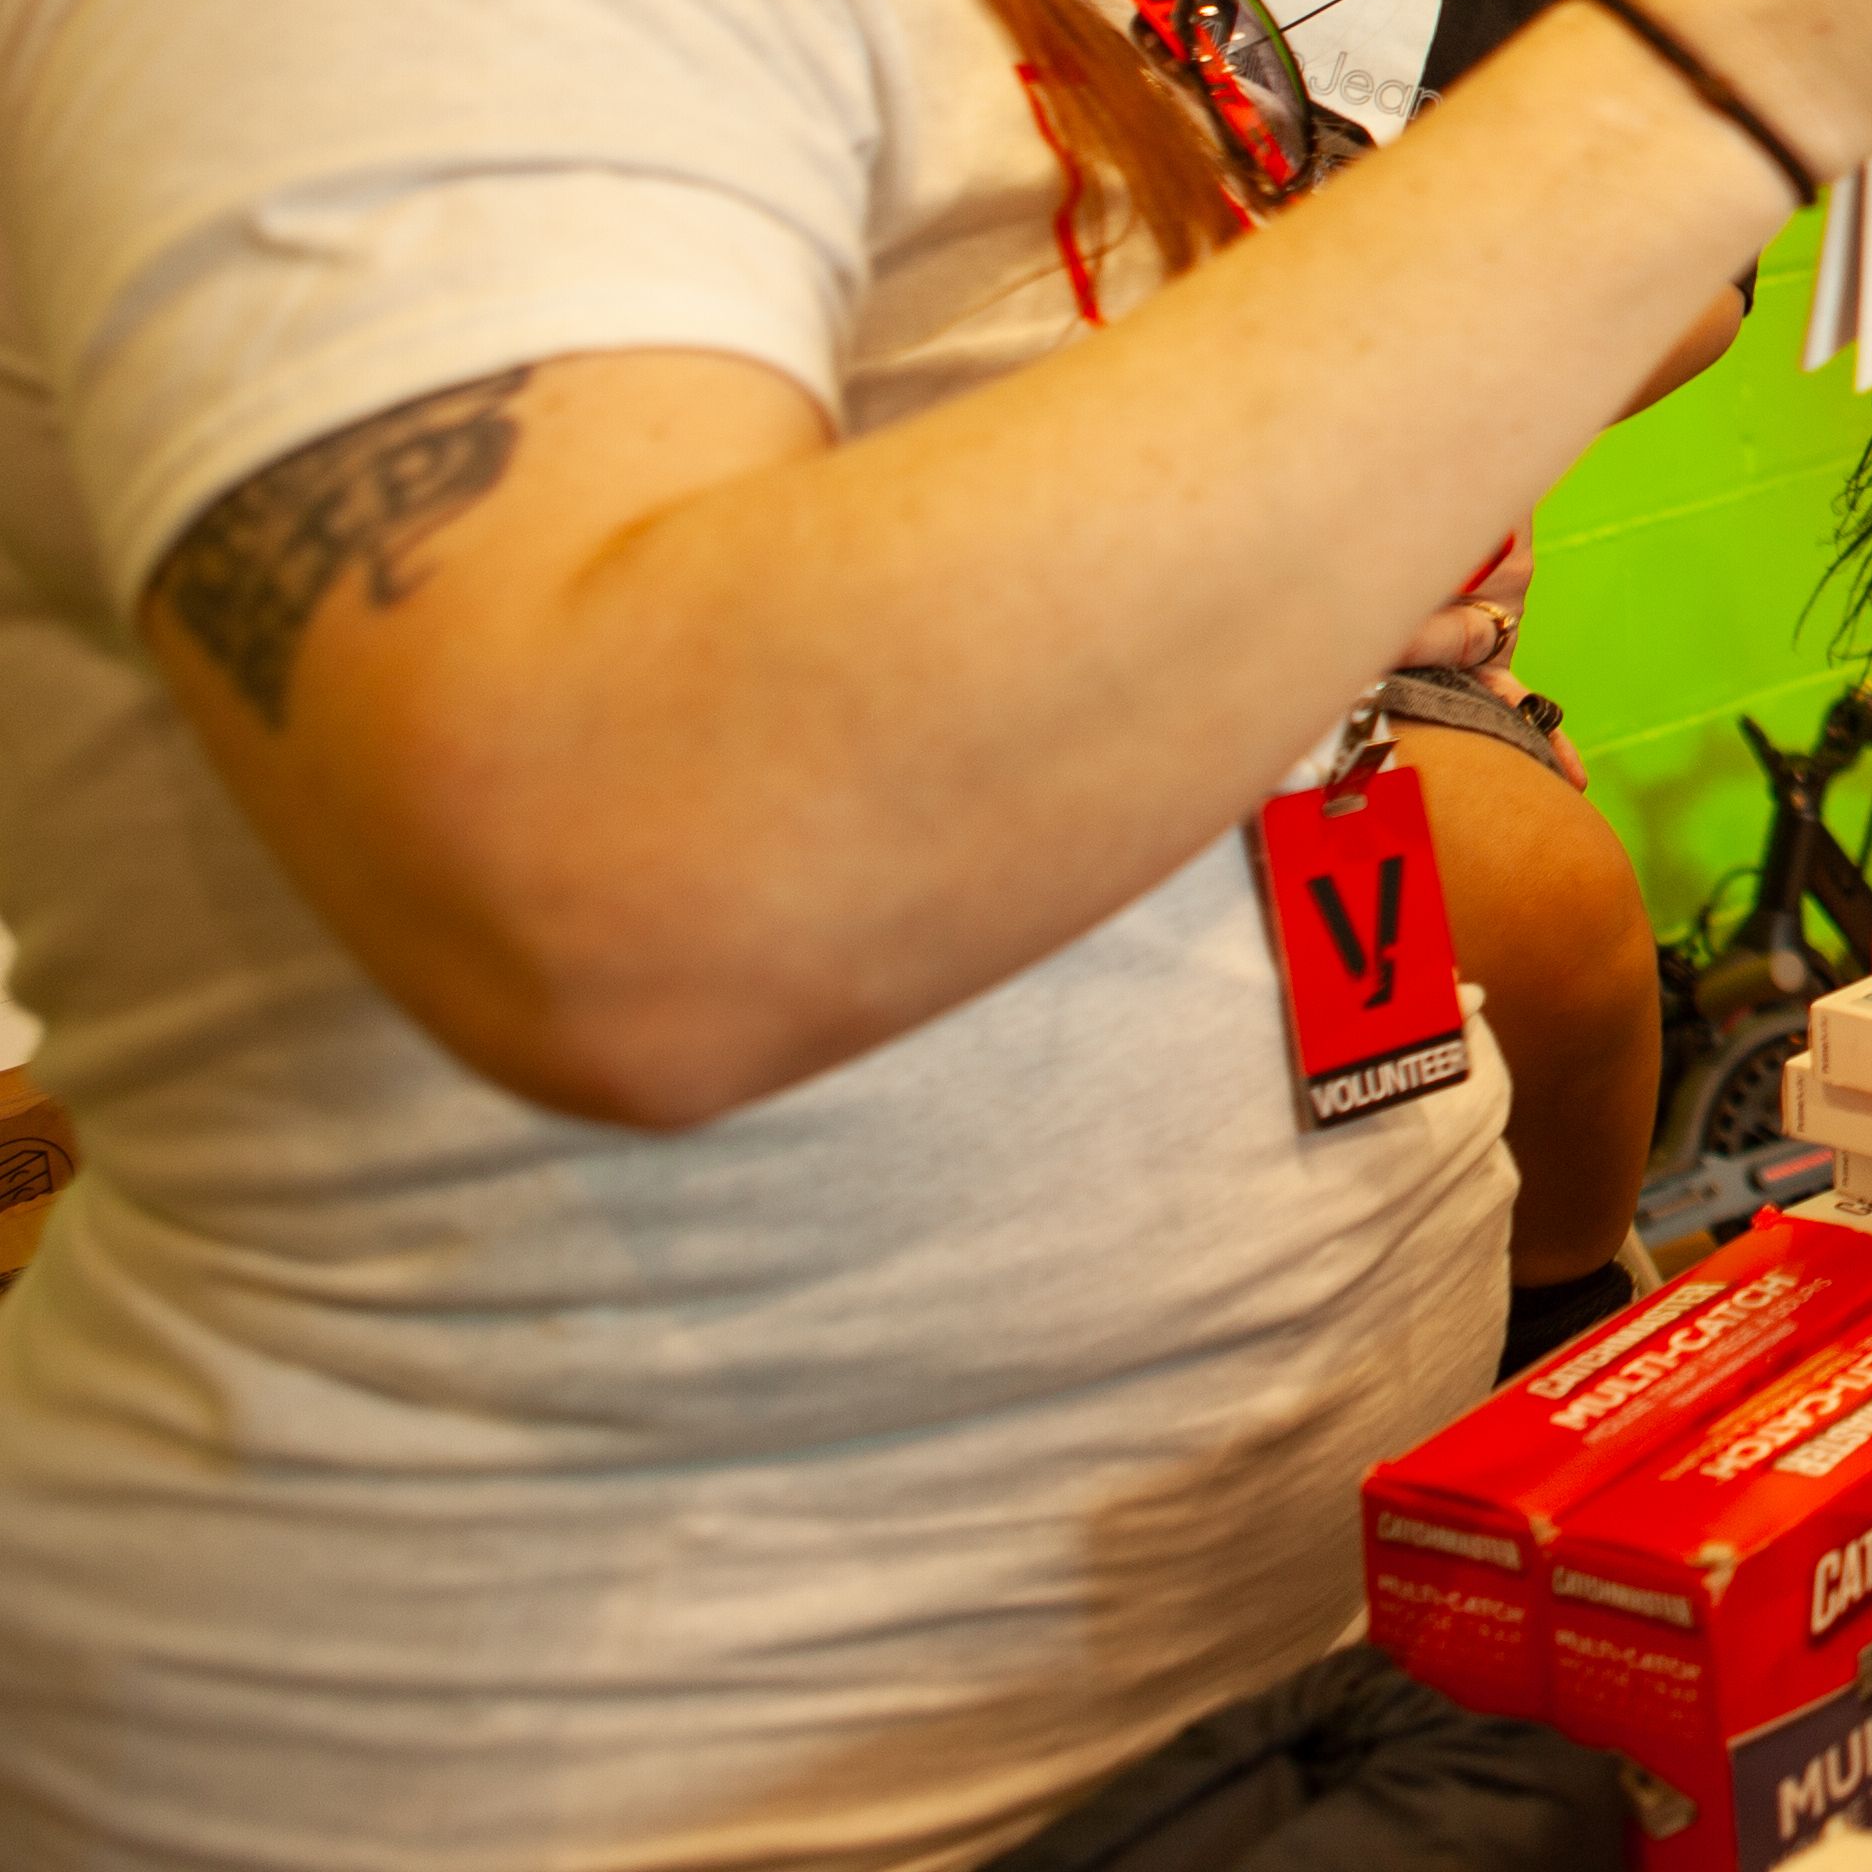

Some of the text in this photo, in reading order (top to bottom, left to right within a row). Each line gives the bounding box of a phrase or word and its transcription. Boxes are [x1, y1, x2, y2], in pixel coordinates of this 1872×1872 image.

[1308, 50, 1443, 121] Jean
[1310, 1039, 1469, 1119] VOLUNTEER
[1550, 1268, 1806, 1430] MULTI-CATCH
